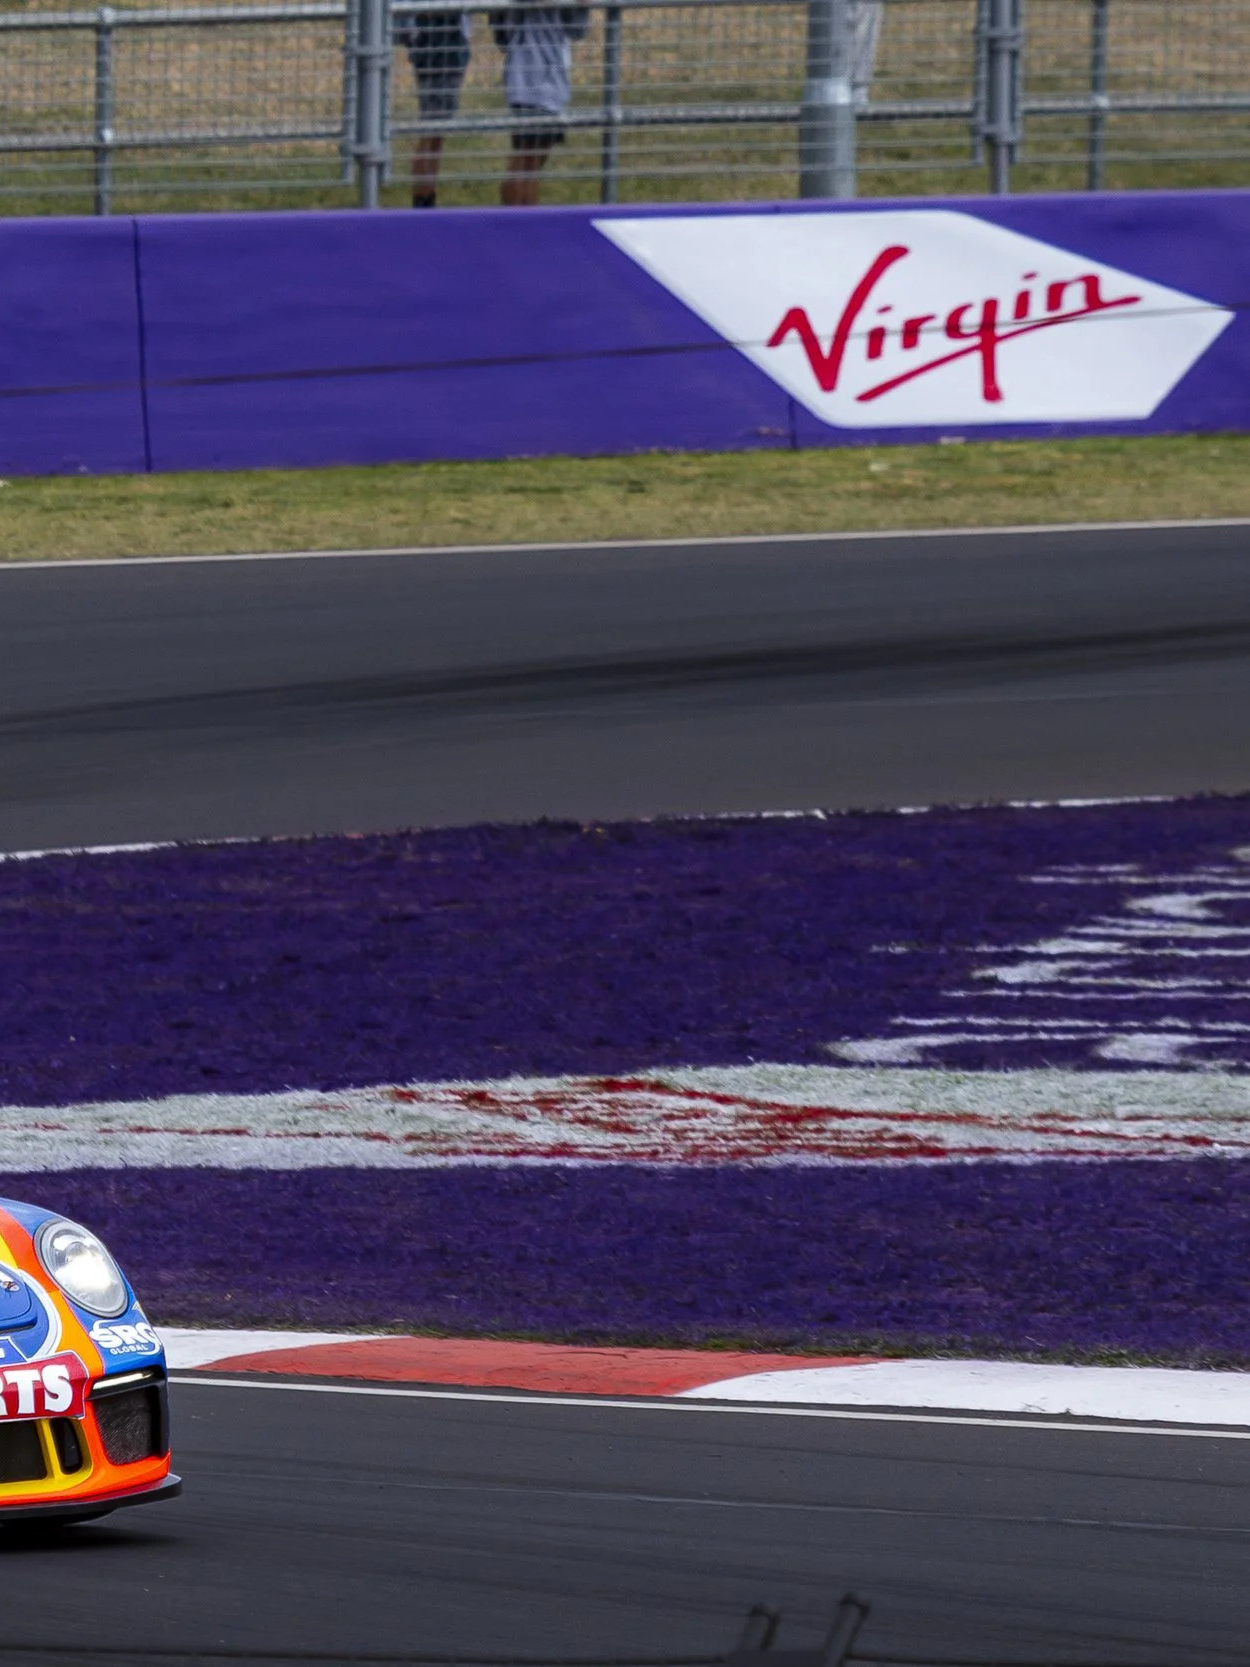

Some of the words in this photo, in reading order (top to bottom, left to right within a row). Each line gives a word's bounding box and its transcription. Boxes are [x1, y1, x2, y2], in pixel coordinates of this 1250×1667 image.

[766, 244, 1142, 402] Virgin
[89, 1319, 161, 1355] SRG
[110, 1344, 149, 1355] GLOBAL
